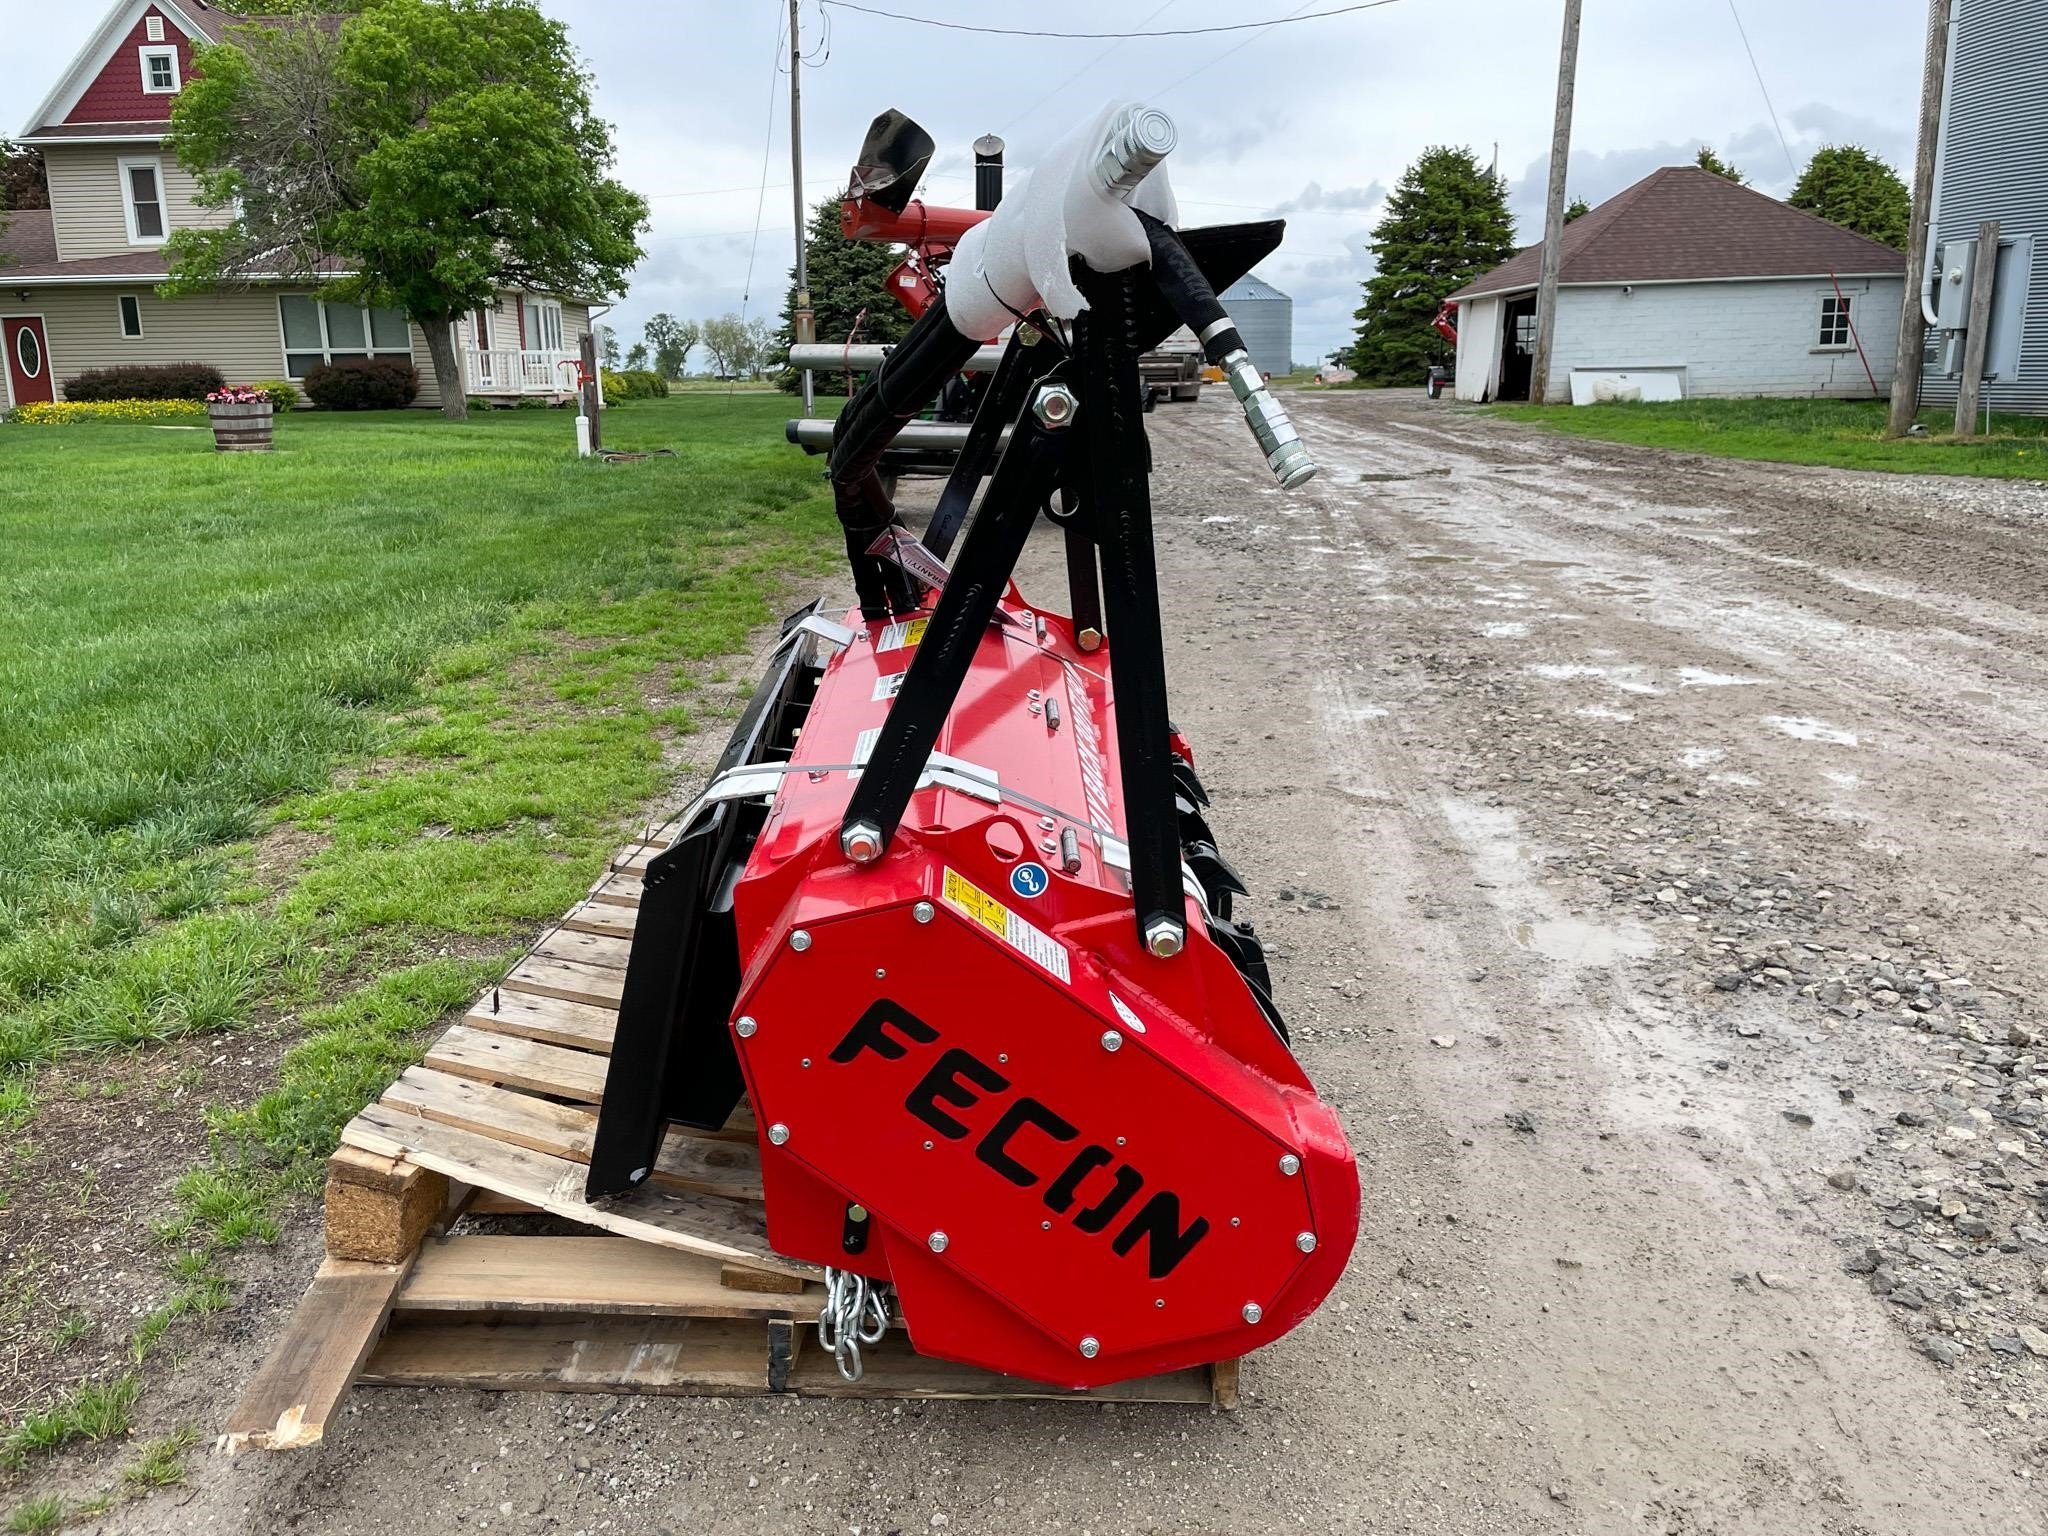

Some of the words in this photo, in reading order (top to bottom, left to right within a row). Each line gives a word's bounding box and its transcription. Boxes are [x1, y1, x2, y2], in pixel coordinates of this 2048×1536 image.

[904, 559, 946, 584] RRANTY!!
[1075, 731, 1109, 809] BACK
[828, 997, 1210, 1280] FECON
